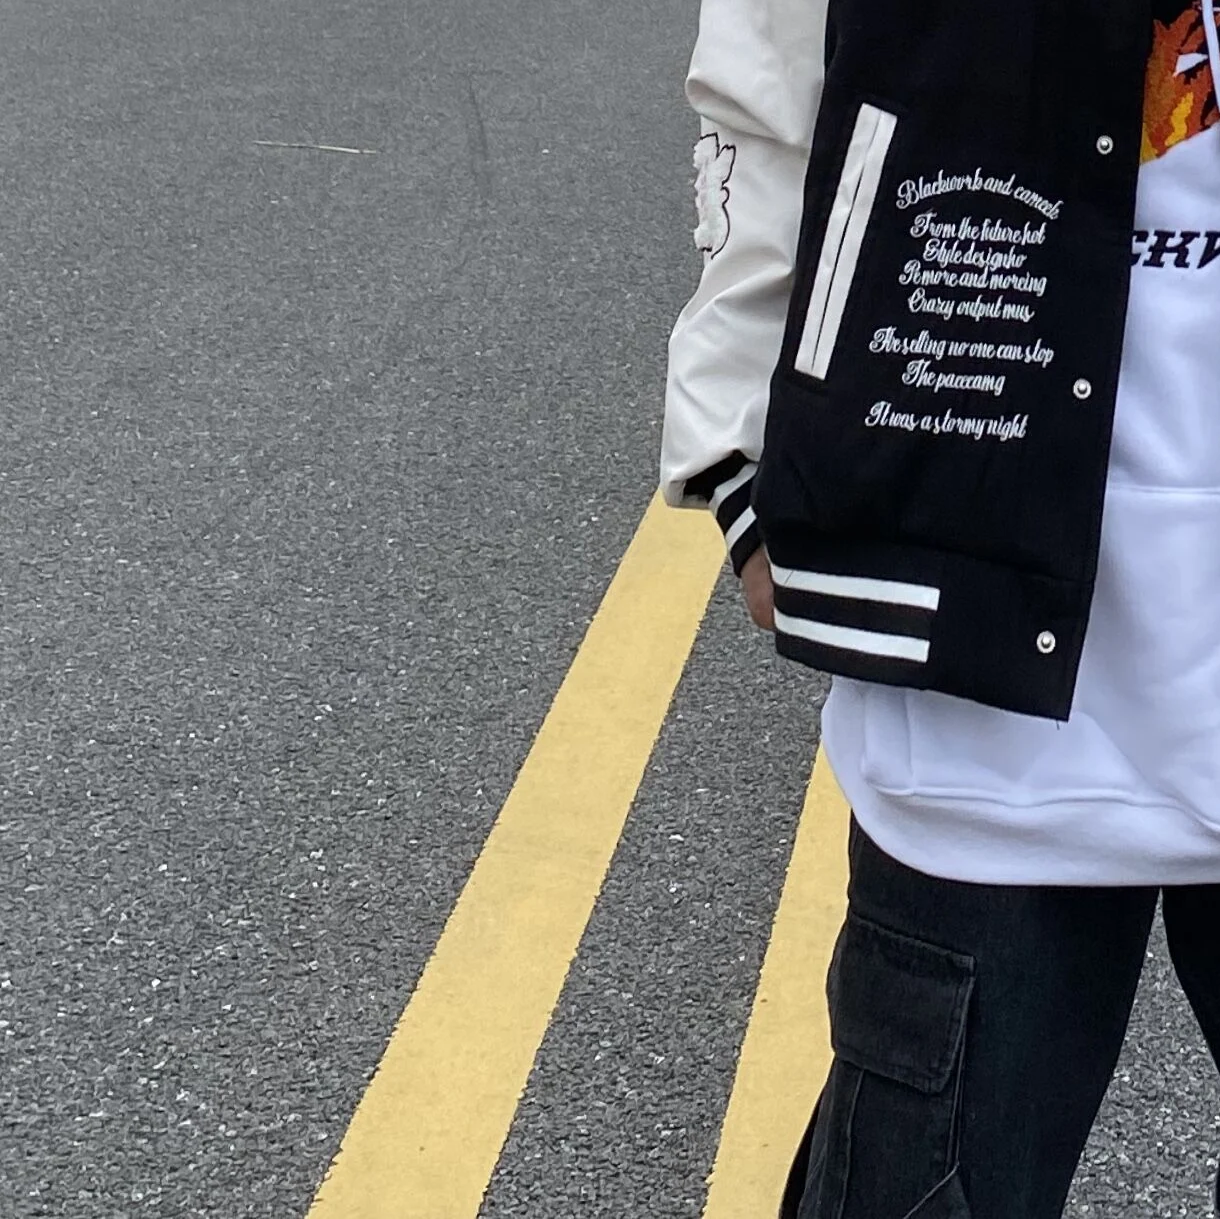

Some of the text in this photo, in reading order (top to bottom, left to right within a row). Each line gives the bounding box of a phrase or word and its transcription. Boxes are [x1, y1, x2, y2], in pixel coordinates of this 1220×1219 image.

[983, 174, 1015, 195] and
[910, 209, 1047, 246] From the future hot
[923, 238, 963, 268] Style
[958, 266, 989, 288] and
[908, 287, 955, 320] Crazy
[956, 294, 1003, 322] output
[869, 325, 1054, 368] The selling no one can stop
[902, 359, 937, 388] The
[864, 400, 1030, 441] It was a stormy night
